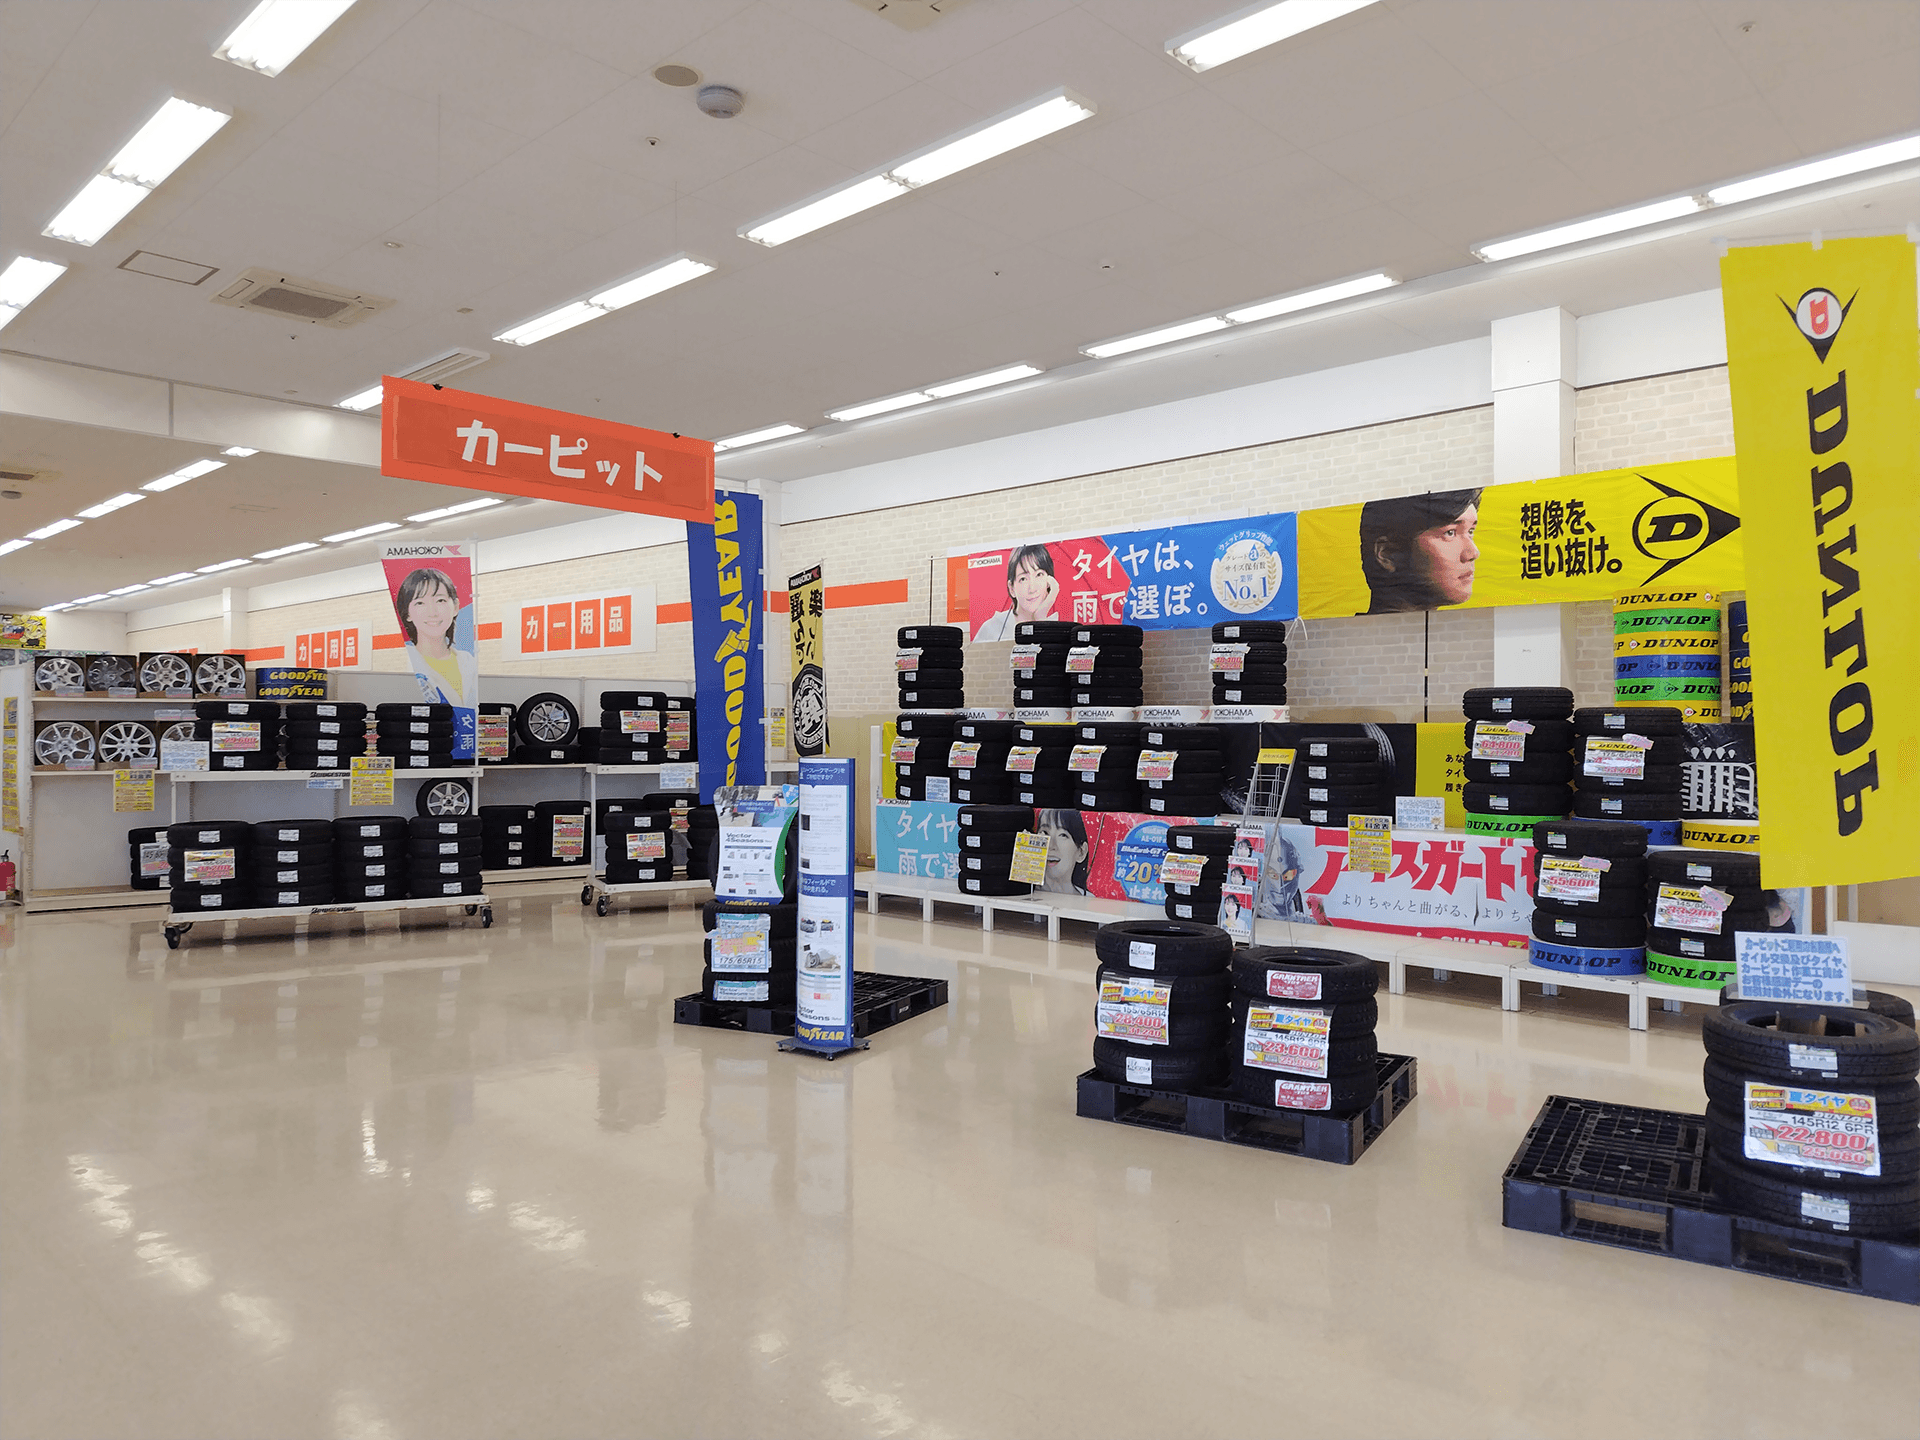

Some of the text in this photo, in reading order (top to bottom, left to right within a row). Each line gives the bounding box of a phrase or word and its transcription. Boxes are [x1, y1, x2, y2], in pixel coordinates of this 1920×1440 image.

[456, 419, 663, 491] カーピット
[1520, 499, 1596, 541] 想像を、
[1072, 540, 1194, 580] タイヤは、
[1520, 536, 1623, 580] 追い抜け。
[1222, 576, 1269, 601] No.1
[1620, 592, 1697, 606] DUNLOP
[1071, 582, 1208, 623] 雨で選ぼ。
[525, 605, 622, 640] カー用品
[1631, 615, 1711, 626] DUNLOP
[298, 636, 356, 662] カー用品
[1643, 638, 1719, 648] DUNLOP
[259, 685, 324, 698] GOODYEAR
[897, 810, 957, 843] タイヤ
[1342, 893, 1469, 920] よりちゃんと曲がる、
[1535, 949, 1621, 967] DUNLOP
[1123, 1006, 1167, 1017] 155/65R14
[1792, 1116, 1875, 1135] 145R12 6PR
